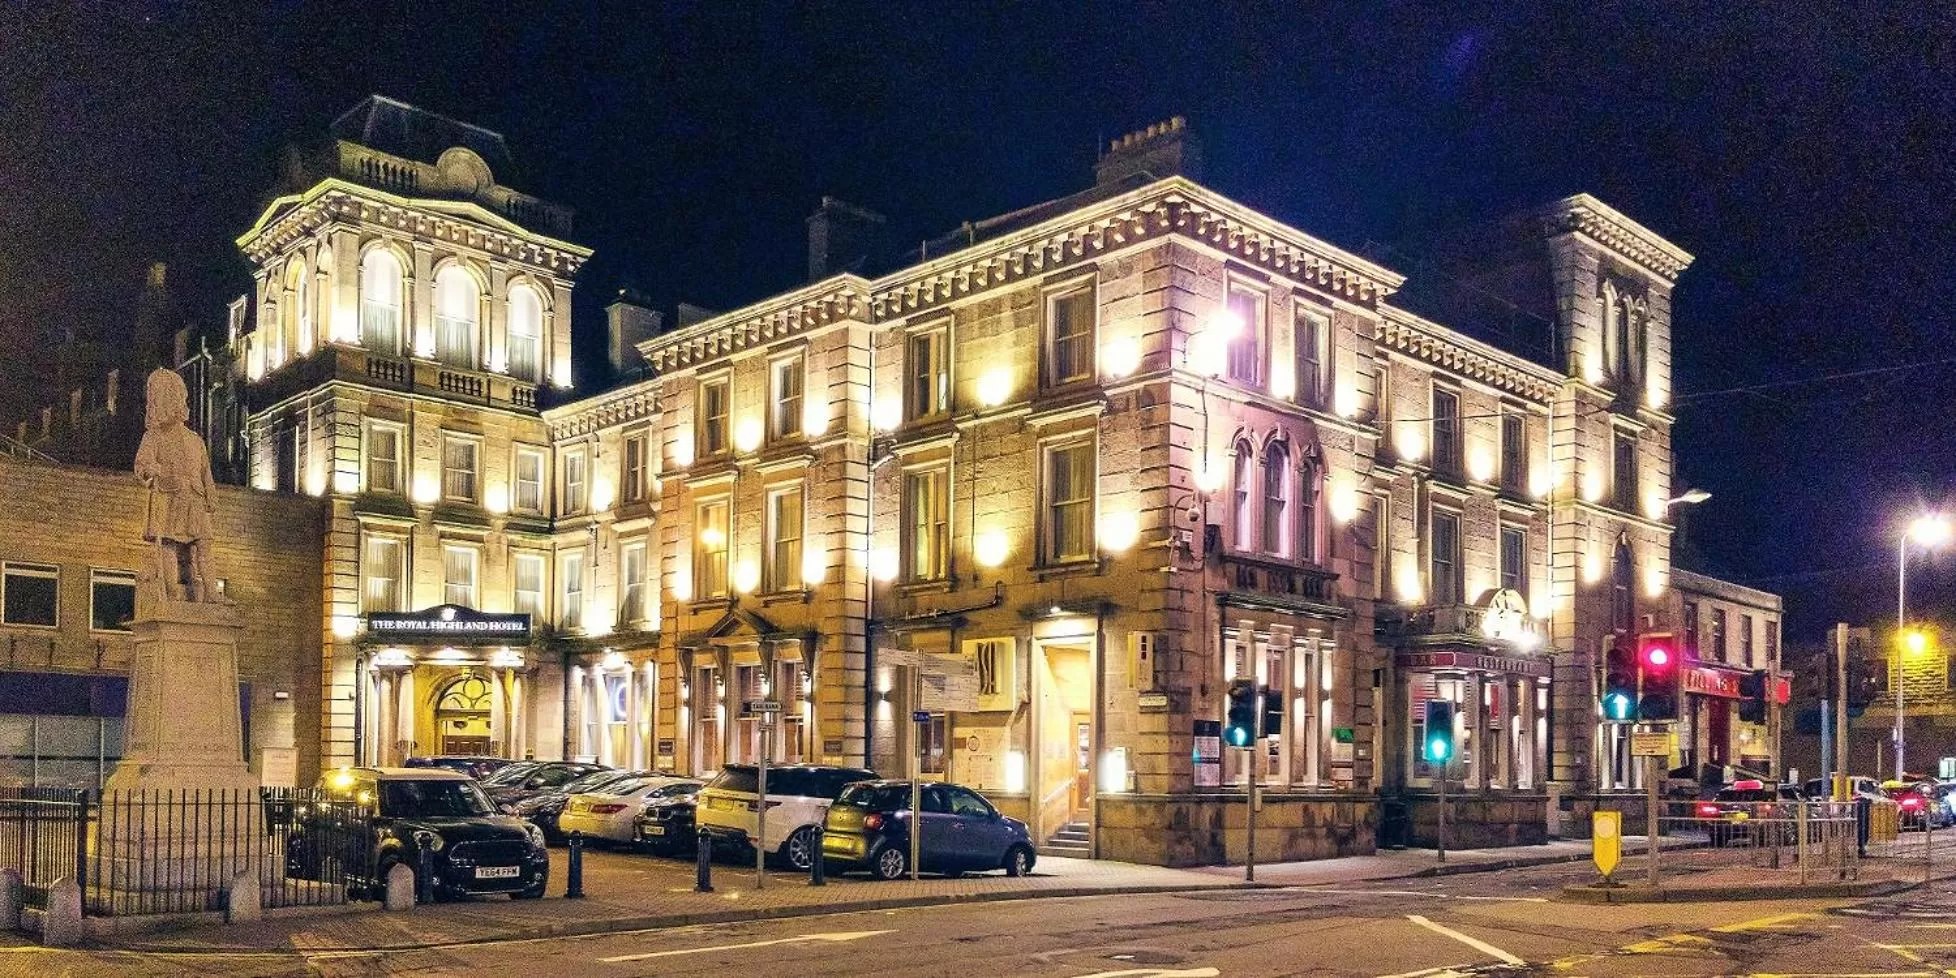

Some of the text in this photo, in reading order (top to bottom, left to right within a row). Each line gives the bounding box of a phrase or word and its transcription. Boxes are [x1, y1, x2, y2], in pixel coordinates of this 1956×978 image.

[372, 620, 527, 631] THE ROYAL HIGHLAND HOTEL
